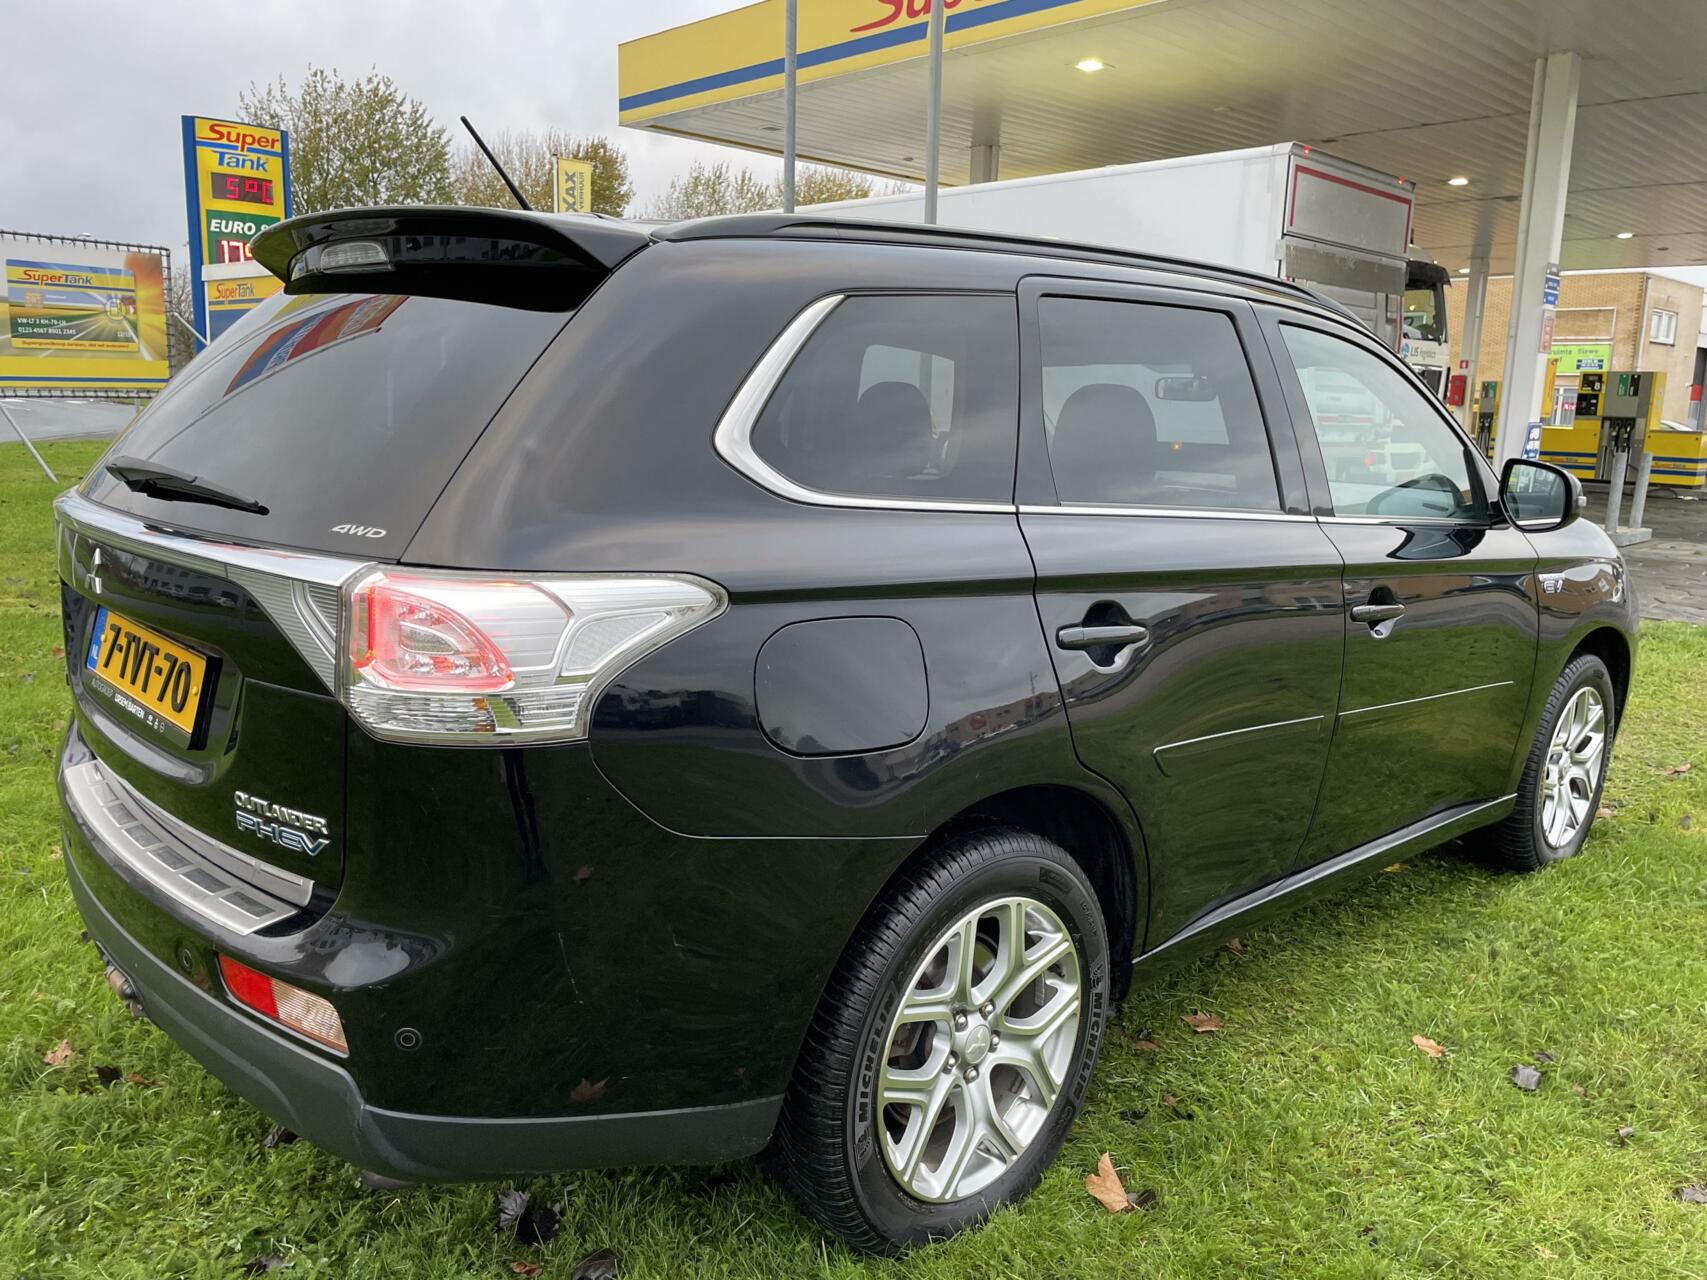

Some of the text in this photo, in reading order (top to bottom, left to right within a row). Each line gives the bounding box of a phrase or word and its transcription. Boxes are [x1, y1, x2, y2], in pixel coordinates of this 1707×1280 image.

[196, 123, 279, 152] Super
[211, 150, 268, 172] Tank
[210, 219, 256, 235] EURO
[17, 269, 92, 286] SuperTank
[214, 283, 254, 304] SuperTank
[331, 524, 387, 538] 4WD
[91, 644, 99, 660] NL
[103, 623, 191, 713] 7-TVT-70
[234, 790, 329, 835] OUTLANDER
[236, 811, 331, 856] PHEV
[859, 991, 897, 1122] MICHELIN
[1073, 992, 1103, 1101] MICHELIN
